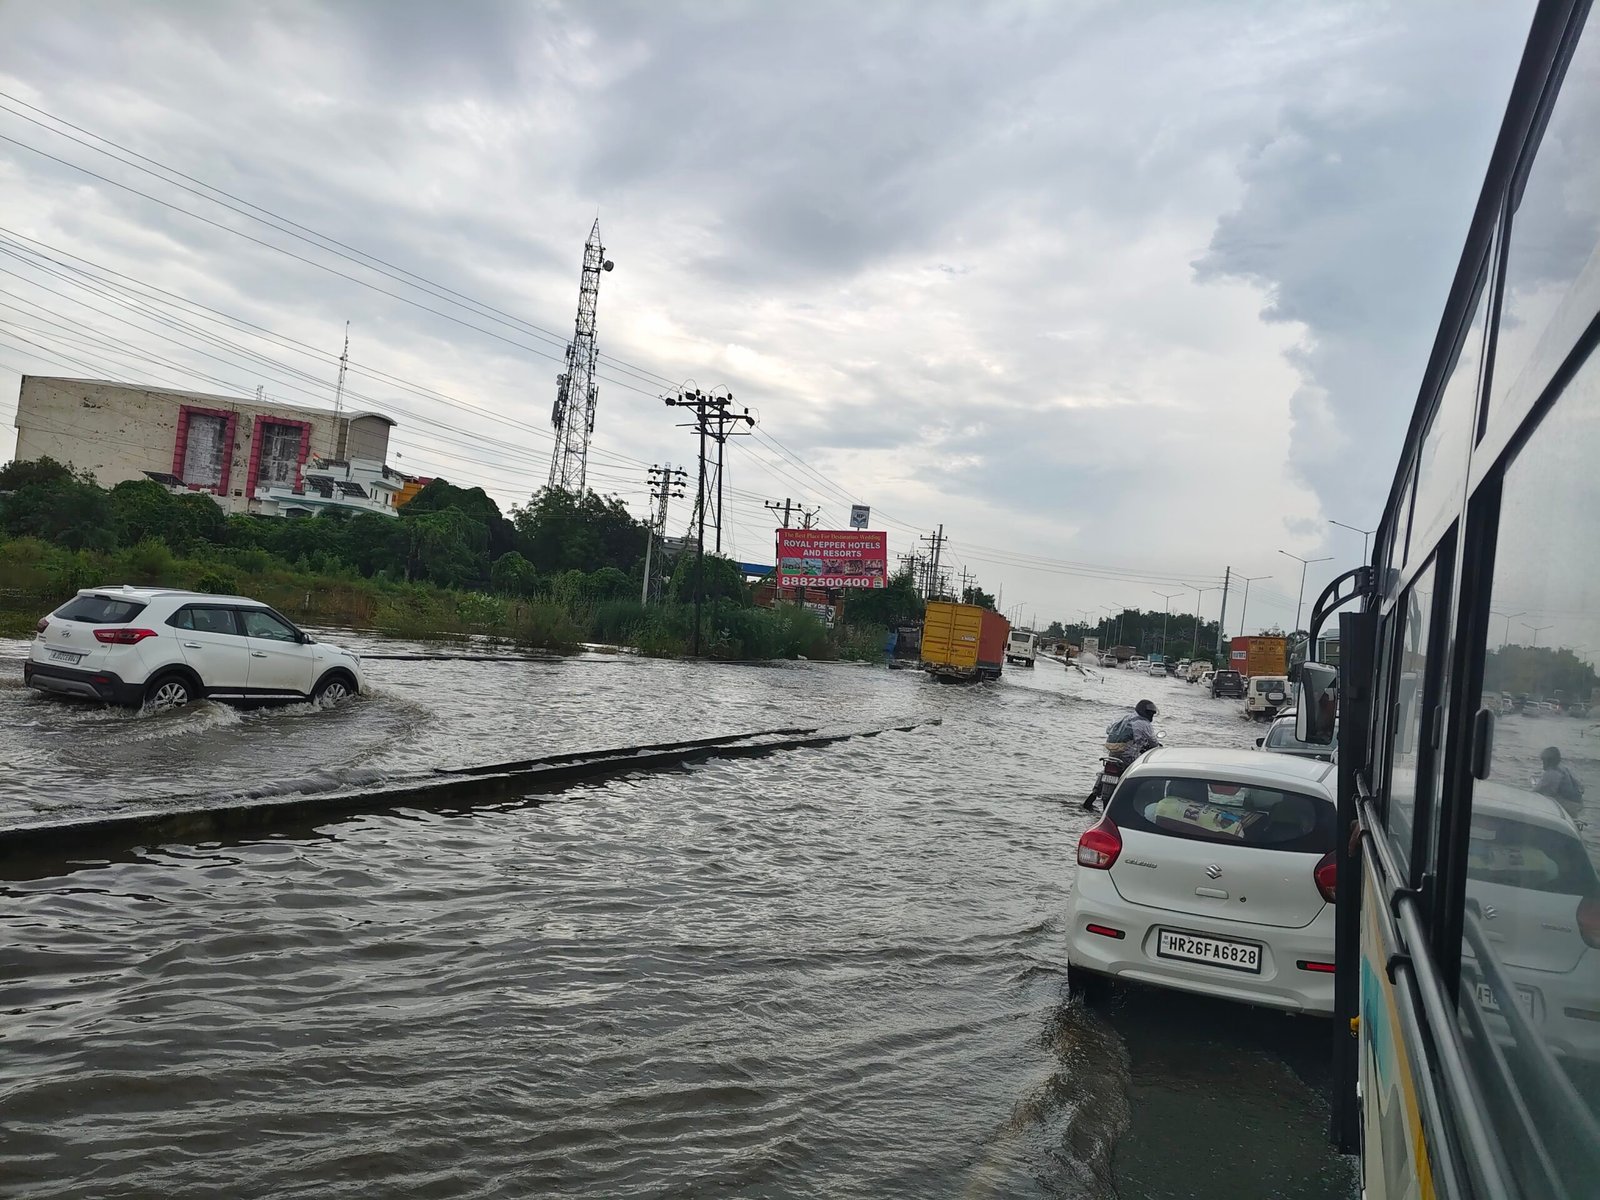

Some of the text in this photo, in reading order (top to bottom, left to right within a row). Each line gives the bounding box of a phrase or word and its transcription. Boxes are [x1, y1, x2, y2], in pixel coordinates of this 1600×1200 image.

[784, 540, 811, 548] ROYAL
[813, 541, 845, 549] PEPPER
[803, 549, 820, 557] AND
[782, 577, 869, 587] 8882500400
[1169, 936, 1256, 964] HR26FA6828
